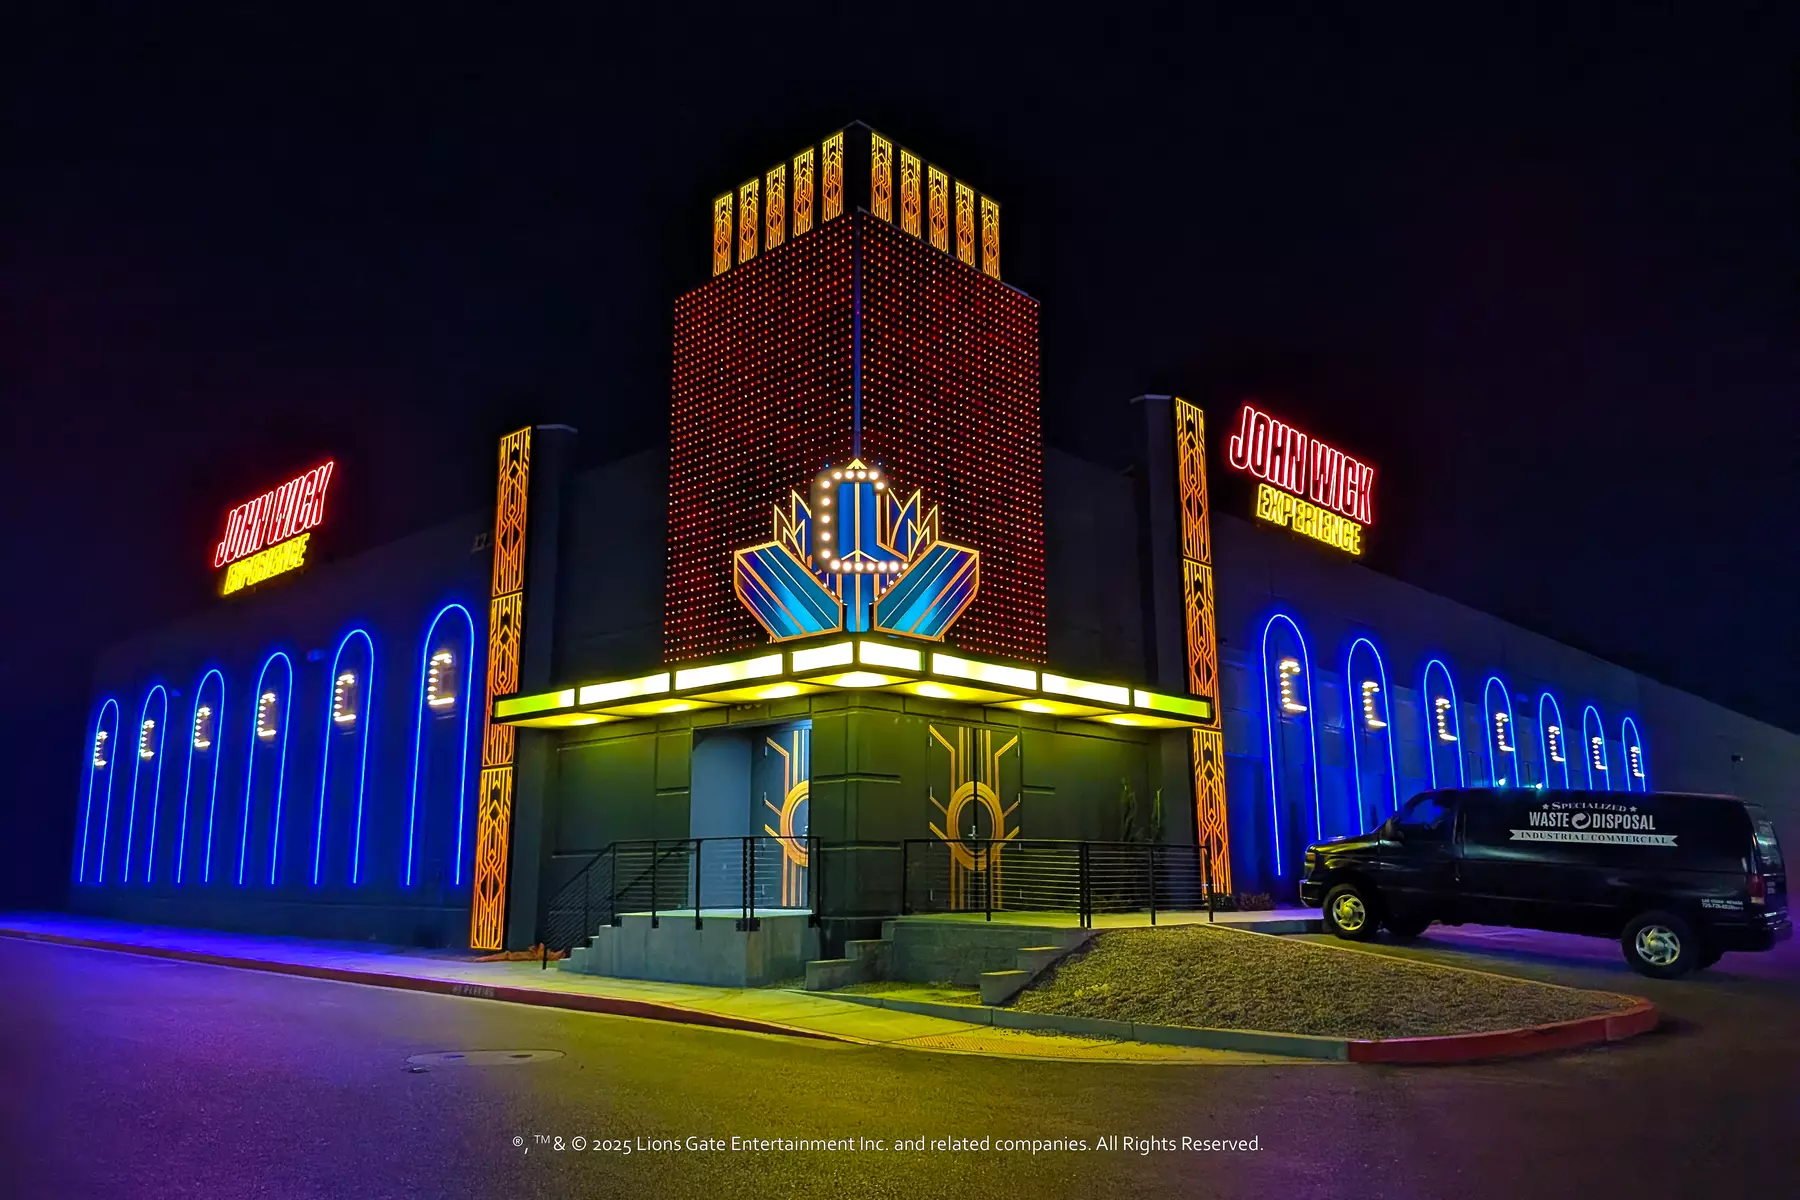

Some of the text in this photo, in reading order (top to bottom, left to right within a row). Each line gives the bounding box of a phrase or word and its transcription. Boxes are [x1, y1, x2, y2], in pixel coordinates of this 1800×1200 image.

[1229, 405, 1374, 525] JOHN WICK
[214, 461, 334, 568] JOHN WICK
[1256, 483, 1362, 555] EXPERIENCE
[1529, 811, 1656, 830] WASTE DISPOSAL
[1551, 801, 1627, 812] SPECIALIZED
[1521, 831, 1669, 844] INDUSTRIAL COMMERCIAL
